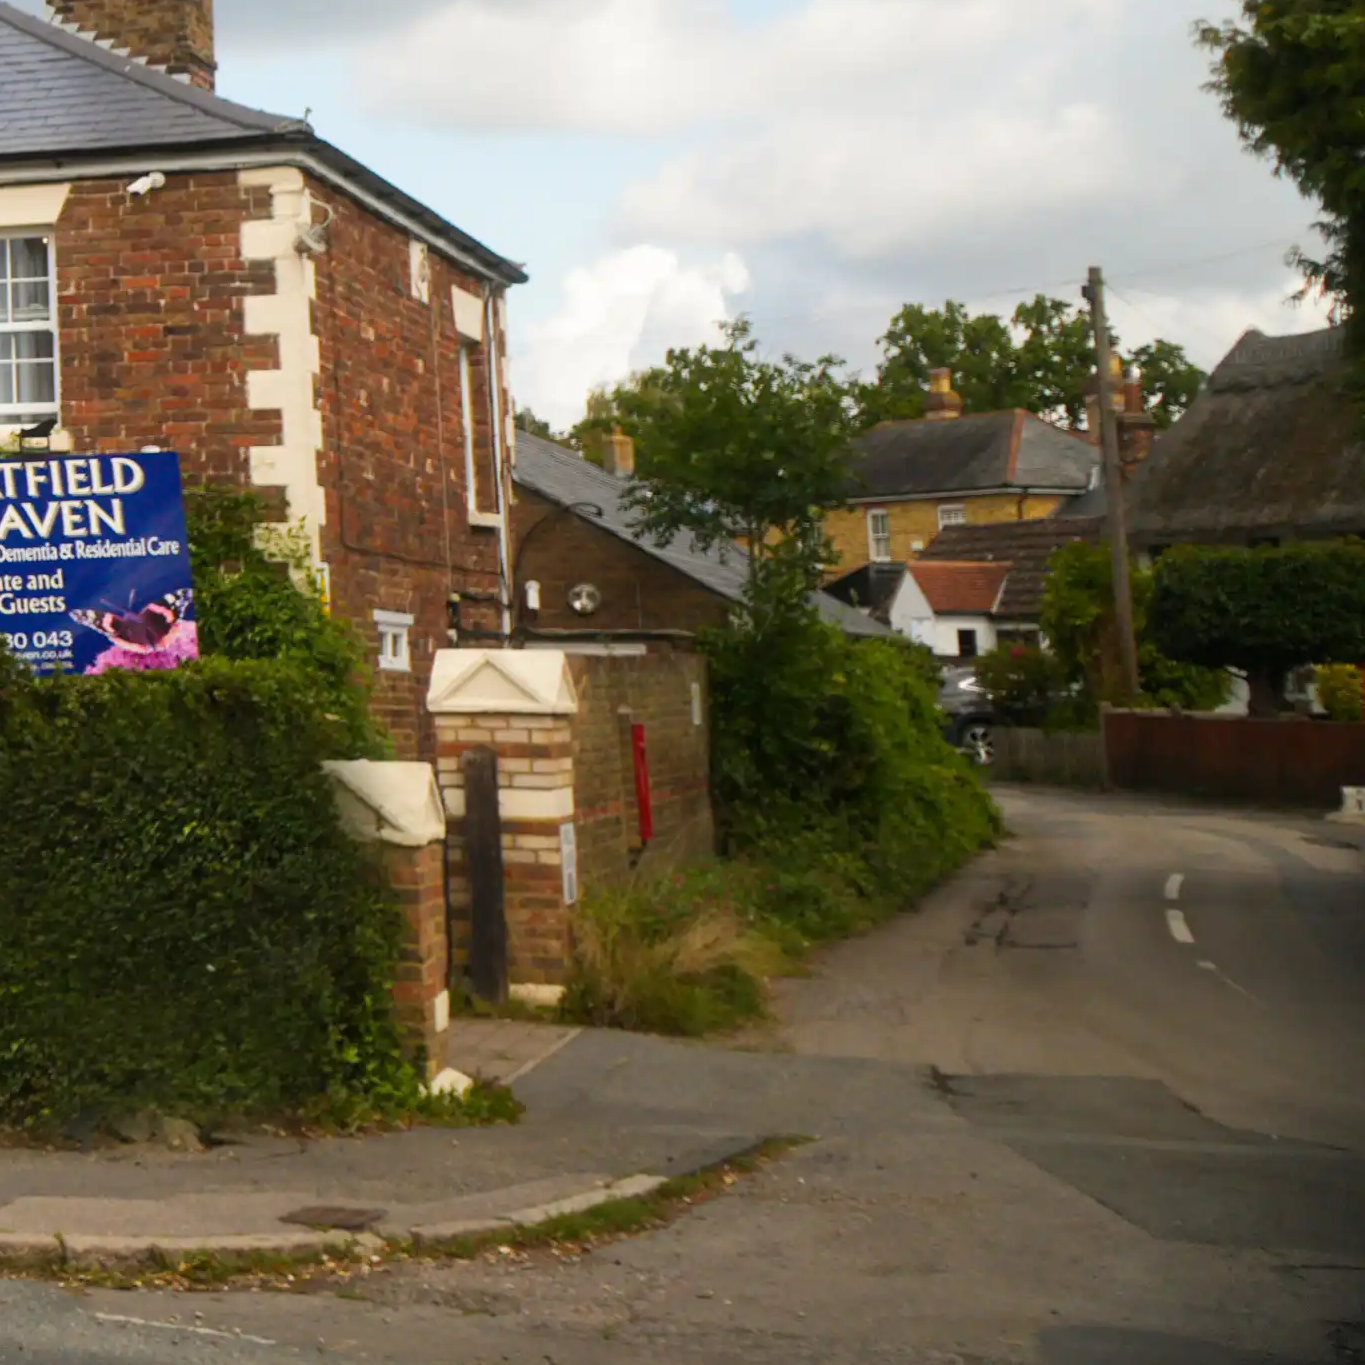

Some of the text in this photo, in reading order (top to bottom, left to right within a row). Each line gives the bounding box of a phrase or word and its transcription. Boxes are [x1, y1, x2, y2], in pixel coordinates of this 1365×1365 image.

[59, 543, 75, 560] &
[75, 538, 147, 559] Residential
[147, 536, 180, 556] Care
[27, 569, 64, 590] and
[32, 630, 73, 648] 043
